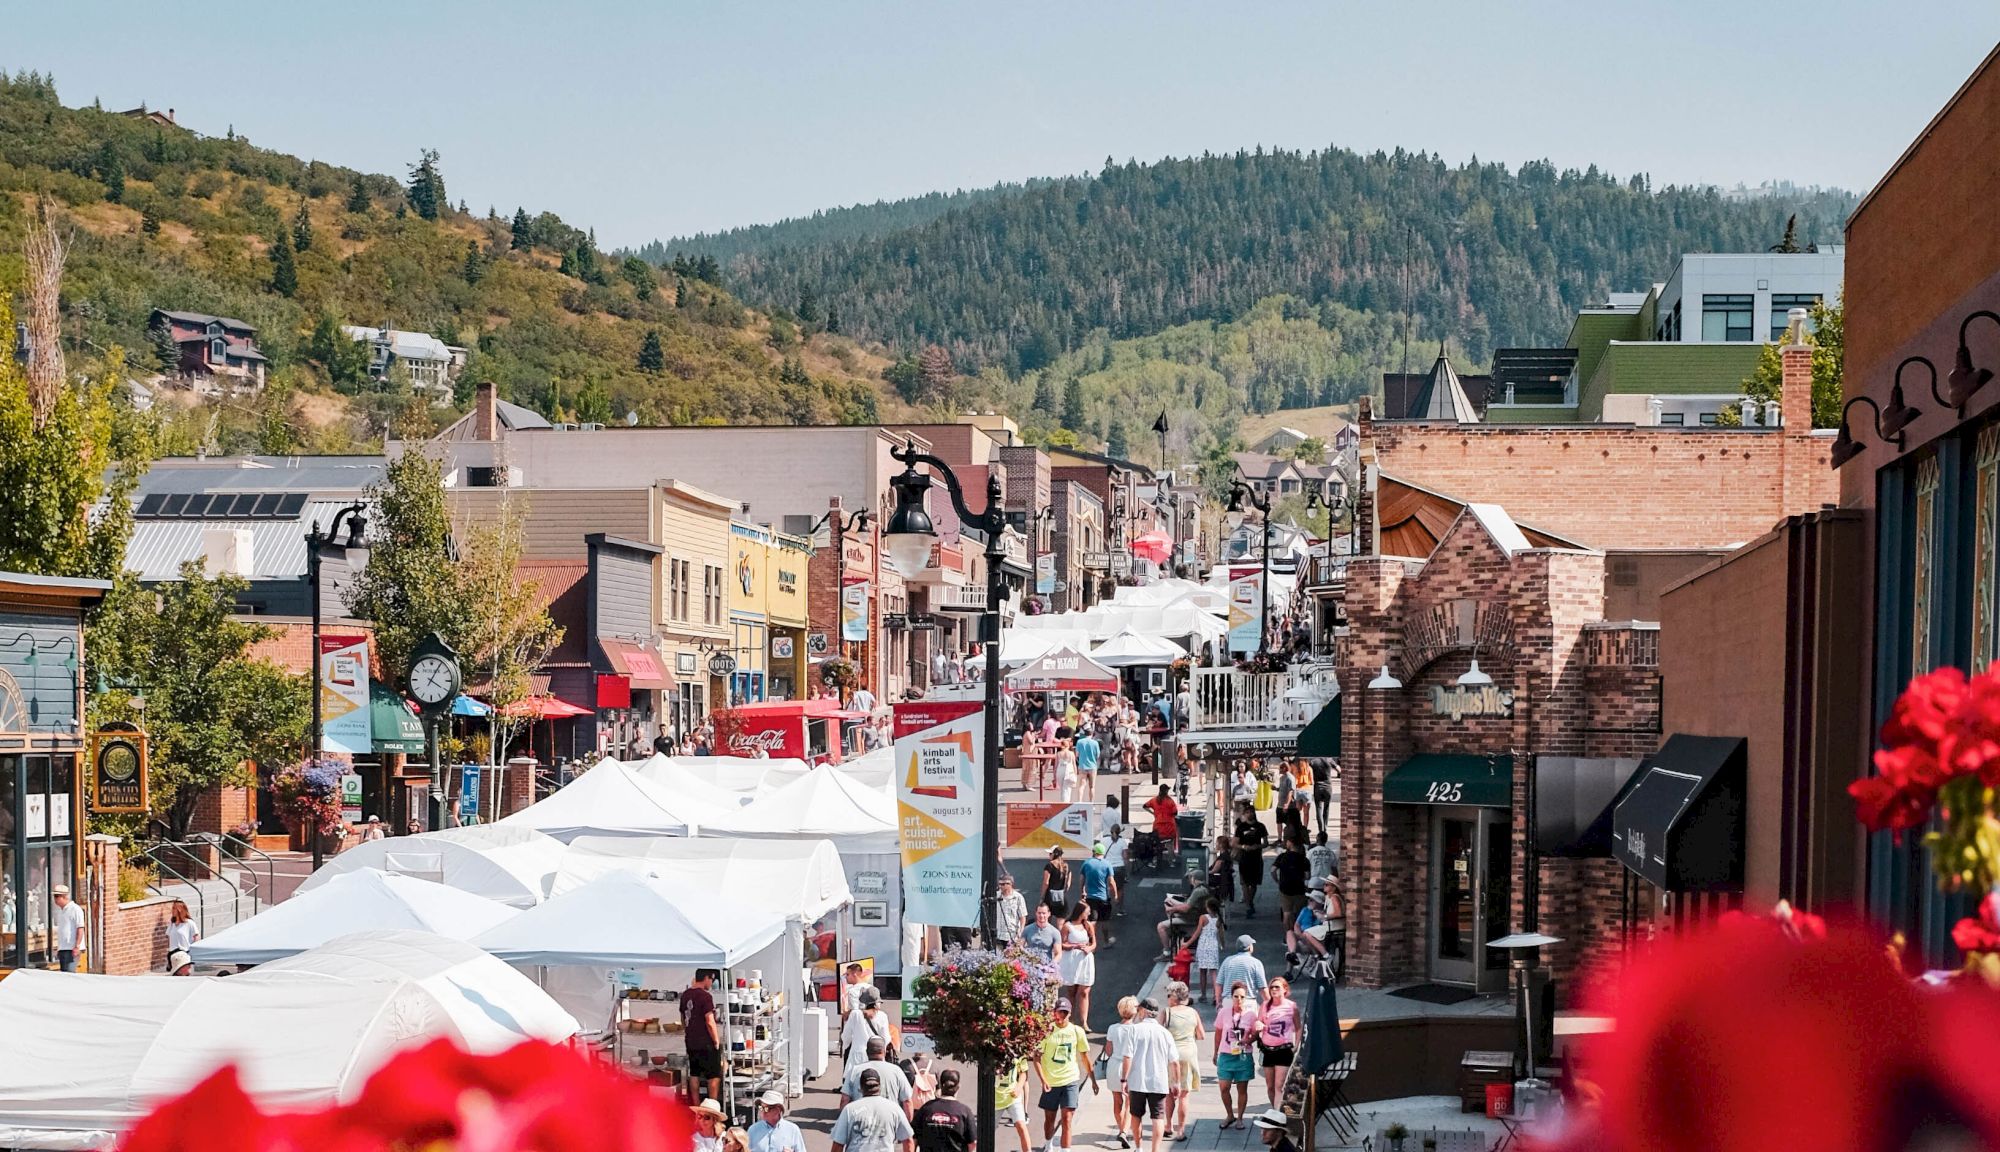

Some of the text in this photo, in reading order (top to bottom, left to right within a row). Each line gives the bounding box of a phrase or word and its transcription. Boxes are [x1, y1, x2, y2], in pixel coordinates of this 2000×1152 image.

[710, 659, 735, 670] ROOTS
[1216, 741, 1264, 750] WOODBURY
[922, 748, 955, 757] kimball
[924, 766, 955, 774] festival
[100, 786, 120, 794] PARK
[1426, 782, 1464, 802] 425
[932, 808, 958, 816] august
[904, 816, 923, 826] art.
[904, 826, 946, 838] cuisine.
[906, 840, 941, 849] music.
[906, 1002, 915, 1015] 3
